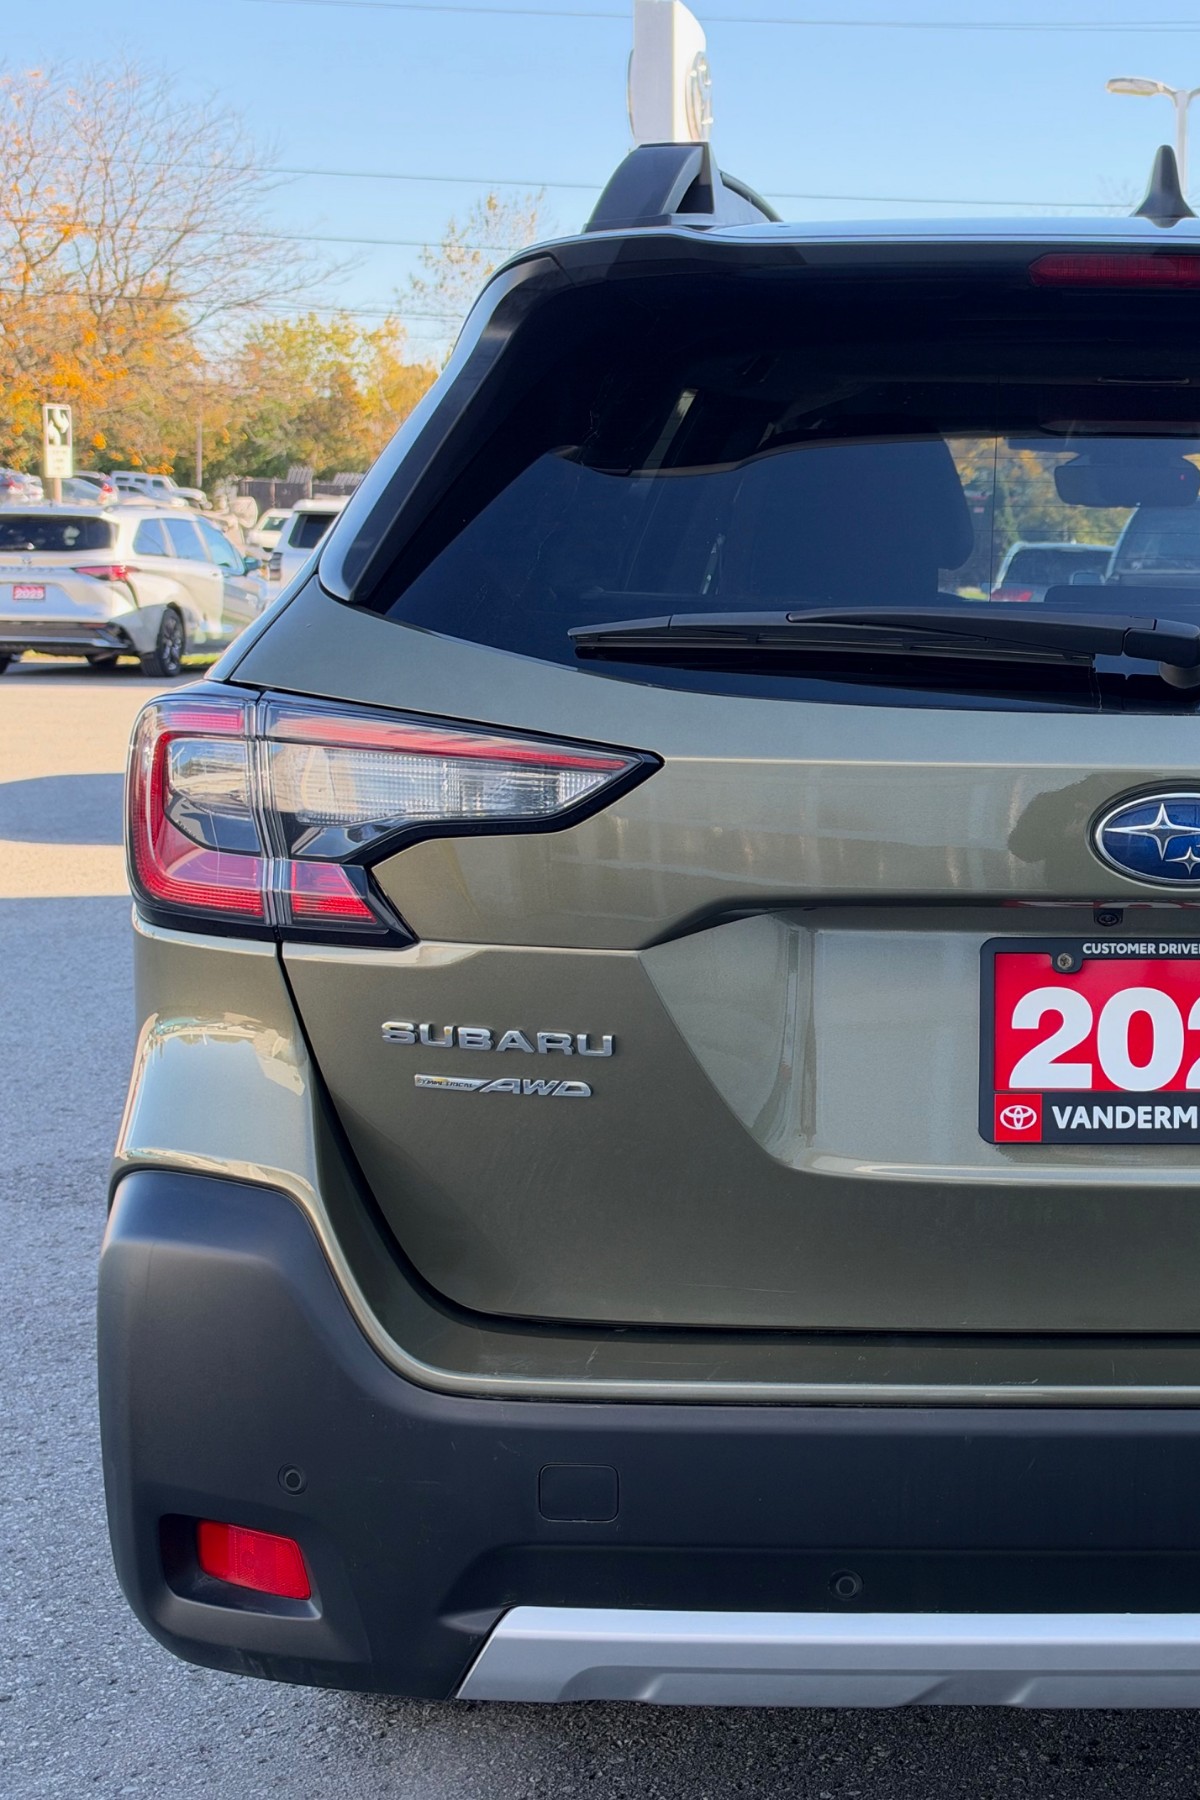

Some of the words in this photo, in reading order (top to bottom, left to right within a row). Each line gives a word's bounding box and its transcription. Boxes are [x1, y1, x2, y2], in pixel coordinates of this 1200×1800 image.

[1083, 942, 1157, 956] CUSTOMER
[381, 1020, 615, 1058] SUBARU
[480, 1078, 592, 1098] AWD
